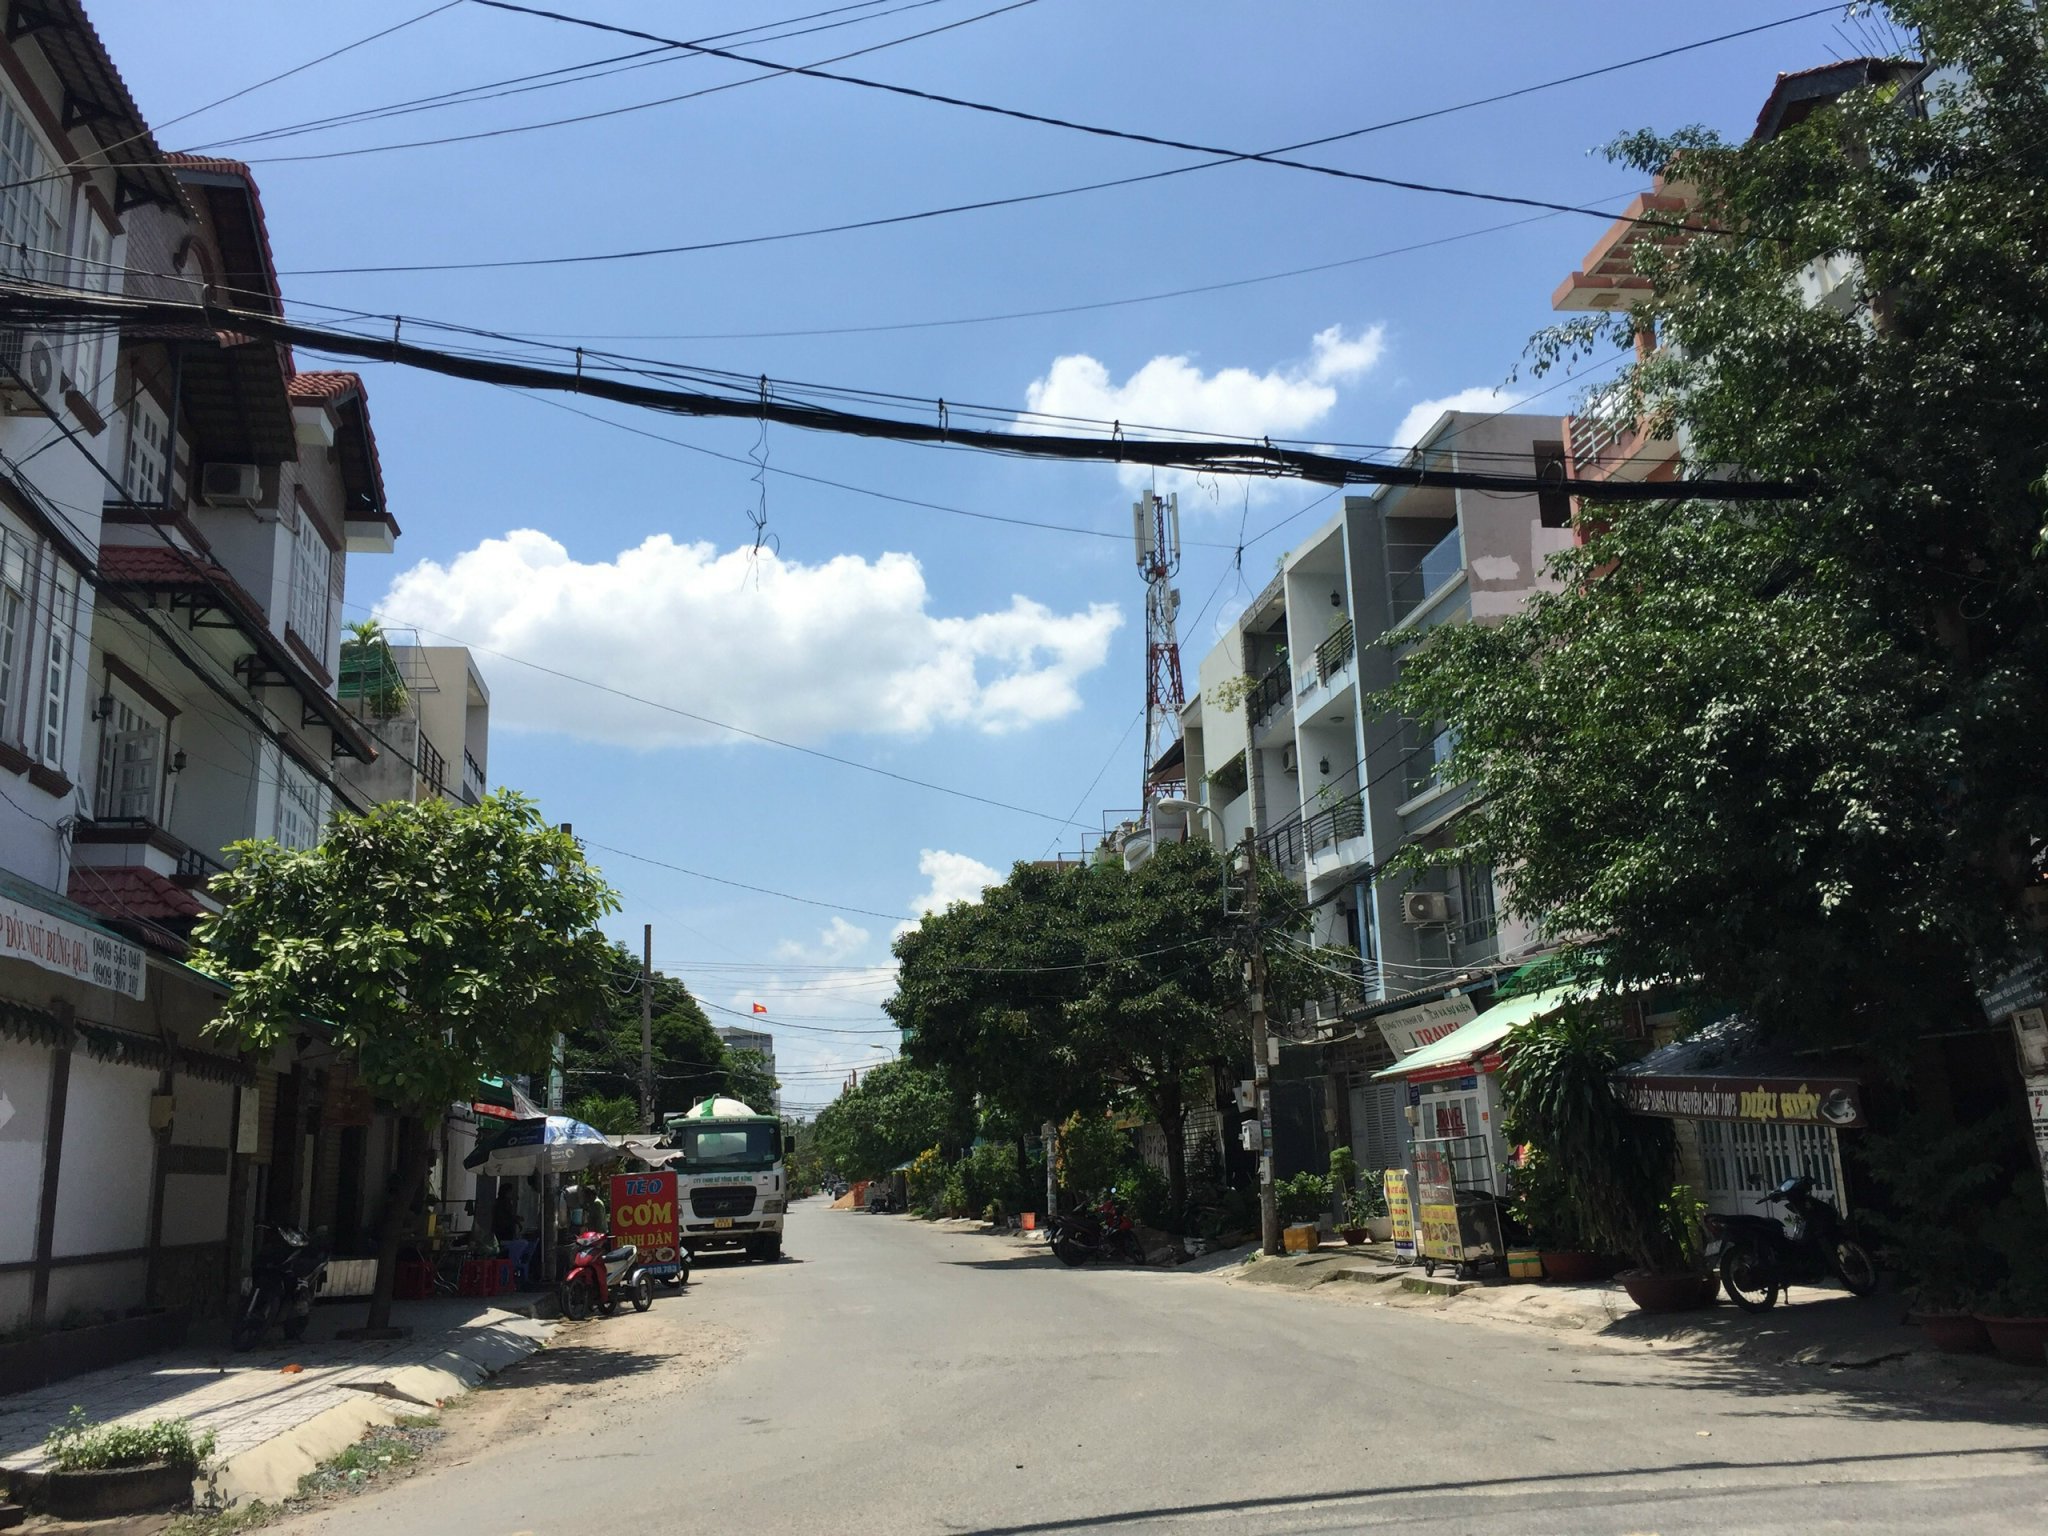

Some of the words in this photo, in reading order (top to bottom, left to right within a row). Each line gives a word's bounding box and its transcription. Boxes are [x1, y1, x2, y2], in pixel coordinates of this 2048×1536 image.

[93, 937, 113, 961] 0909
[93, 962, 113, 986] 0909
[616, 1198, 673, 1228] CƠM
[616, 1232, 646, 1249] BÌNH
[647, 1229, 673, 1247] DÂN
